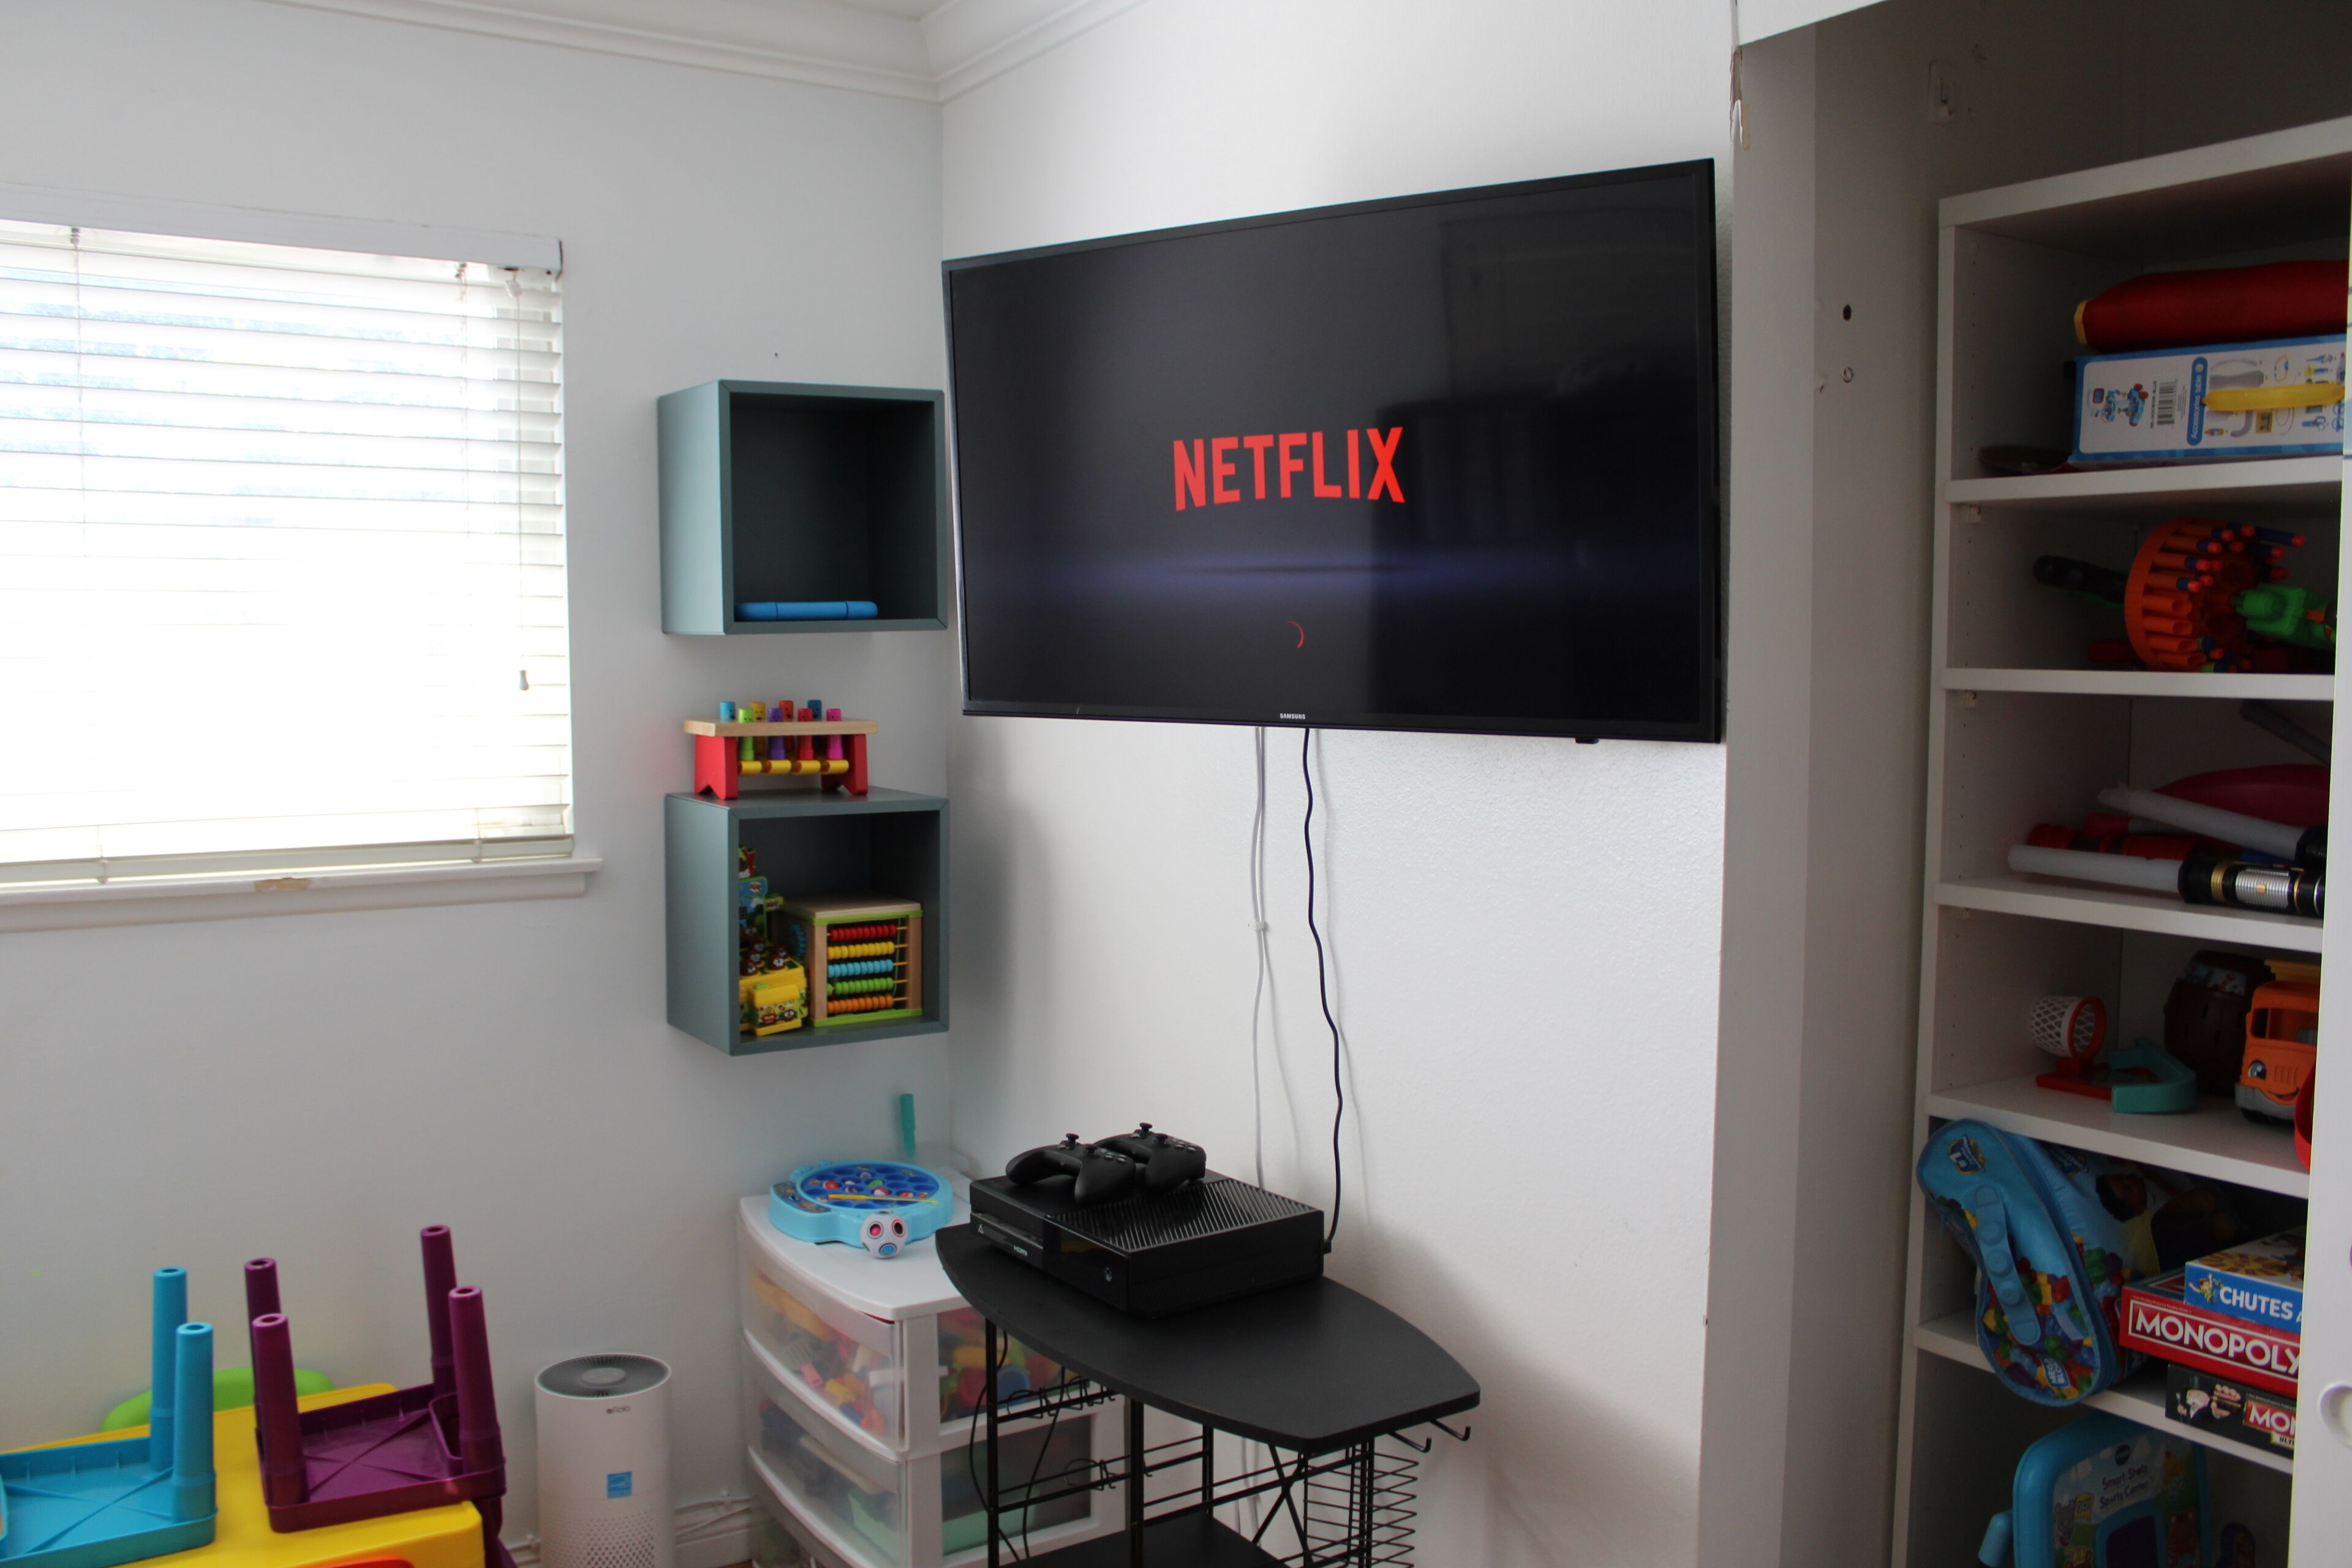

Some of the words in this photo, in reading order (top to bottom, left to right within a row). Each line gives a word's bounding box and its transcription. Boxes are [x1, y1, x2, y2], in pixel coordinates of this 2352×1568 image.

[1173, 426, 1405, 511] NETFLIX
[2219, 1286, 2293, 1321] CHUTES
[2135, 1308, 2300, 1375] MONOPOLY
[2100, 1493, 2124, 1509] Sports
[2124, 1481, 2148, 1498] Center
[2102, 1472, 2125, 1491] Smart
